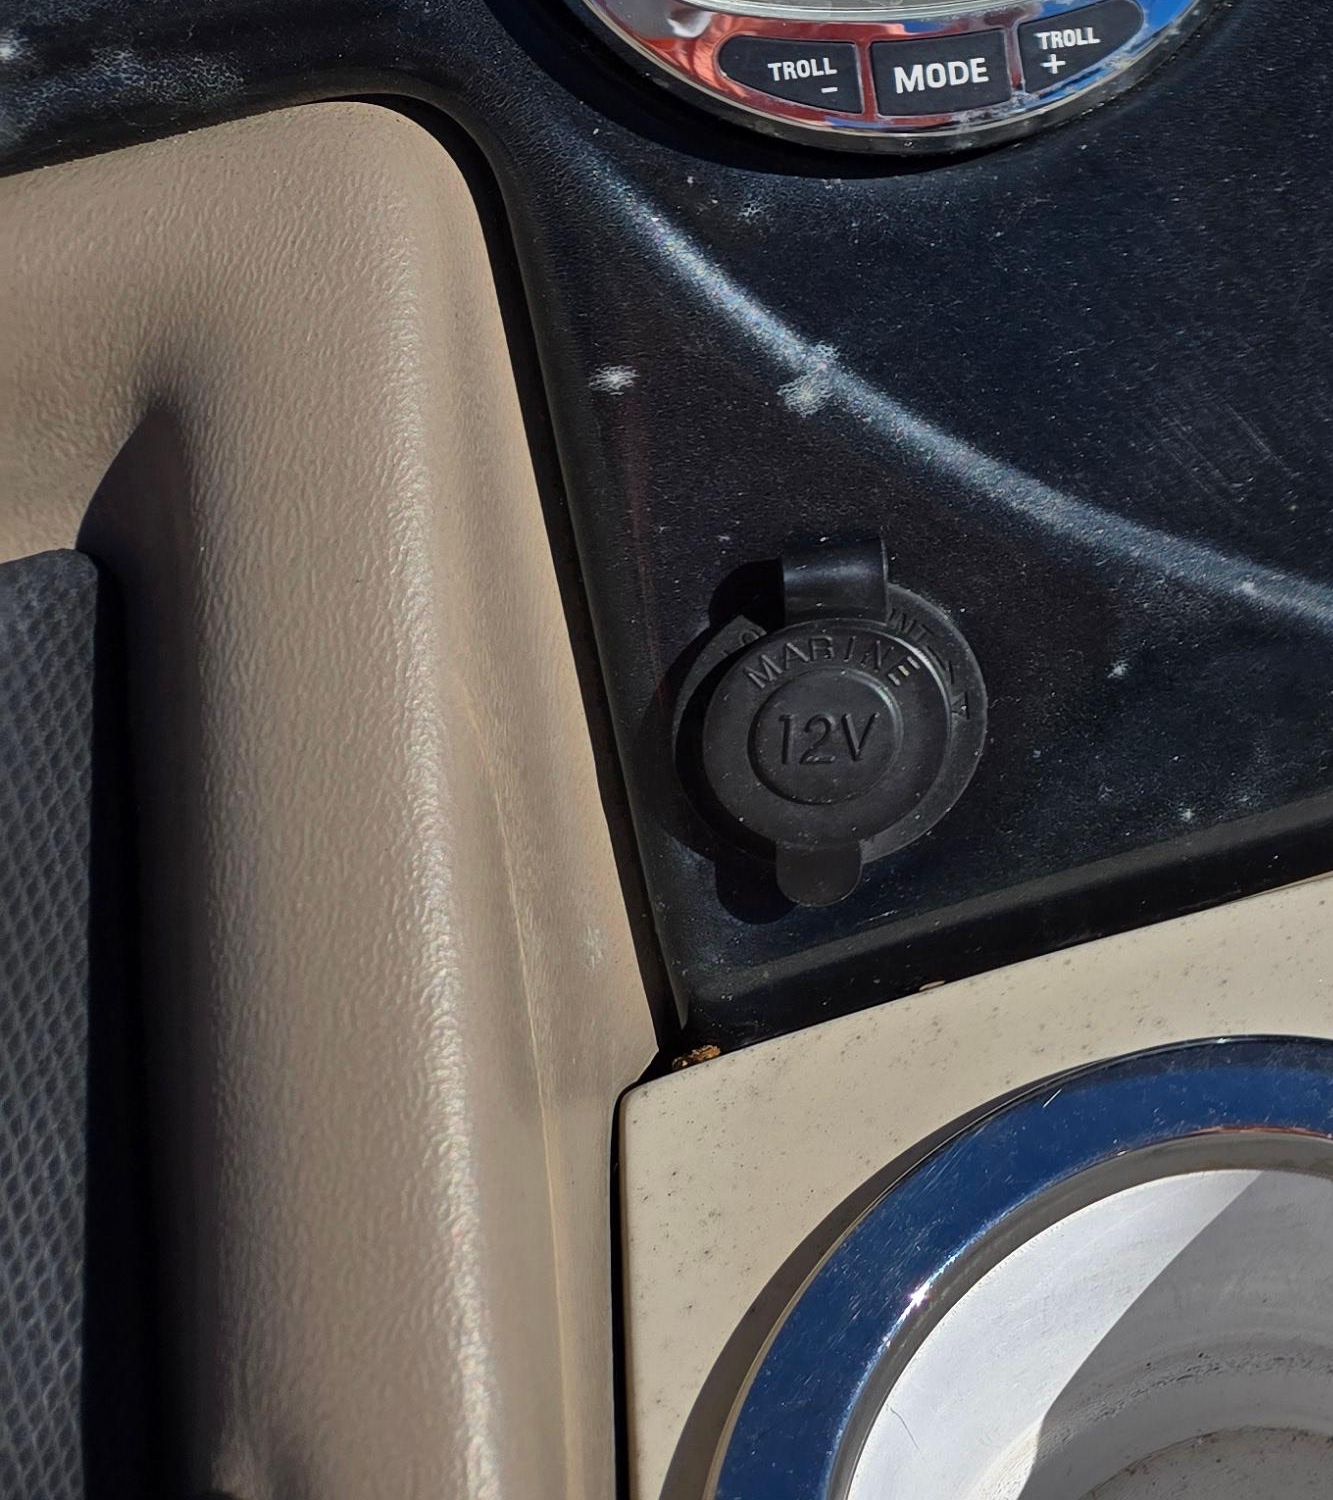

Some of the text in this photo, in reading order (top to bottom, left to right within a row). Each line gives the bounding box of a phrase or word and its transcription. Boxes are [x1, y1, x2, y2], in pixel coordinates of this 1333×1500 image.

[1037, 27, 1100, 50] TROLL
[768, 57, 838, 82] TROLL
[893, 57, 990, 95] MODE
[744, 635, 922, 690] MARINE
[778, 711, 881, 766] 12V
